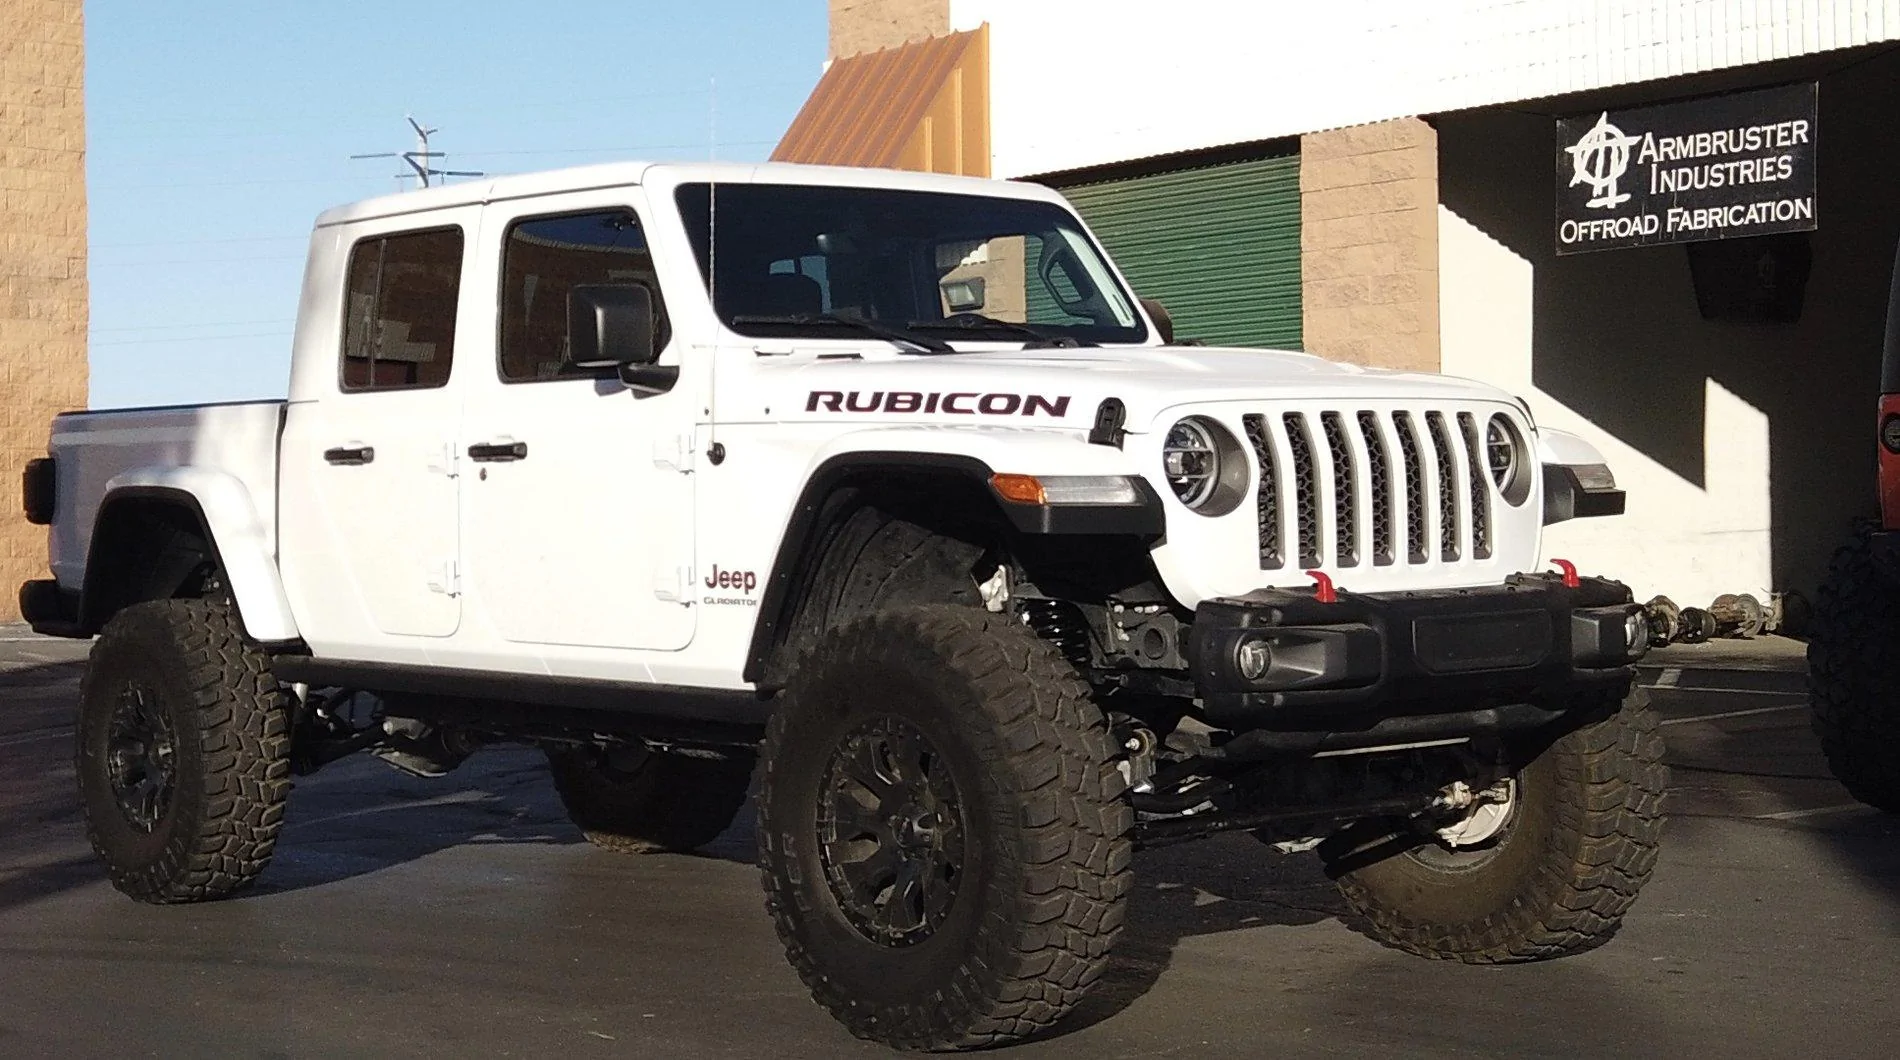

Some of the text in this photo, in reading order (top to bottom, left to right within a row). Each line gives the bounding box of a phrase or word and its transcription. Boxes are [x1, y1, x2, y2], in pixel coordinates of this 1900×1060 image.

[1637, 120, 1808, 164] ARMBRUSTER
[1650, 155, 1793, 195] INDUSTRIES
[1560, 197, 1812, 243] OFFROAD FABRICATION
[805, 391, 1071, 417] RUBICON
[704, 564, 756, 595] Jeep
